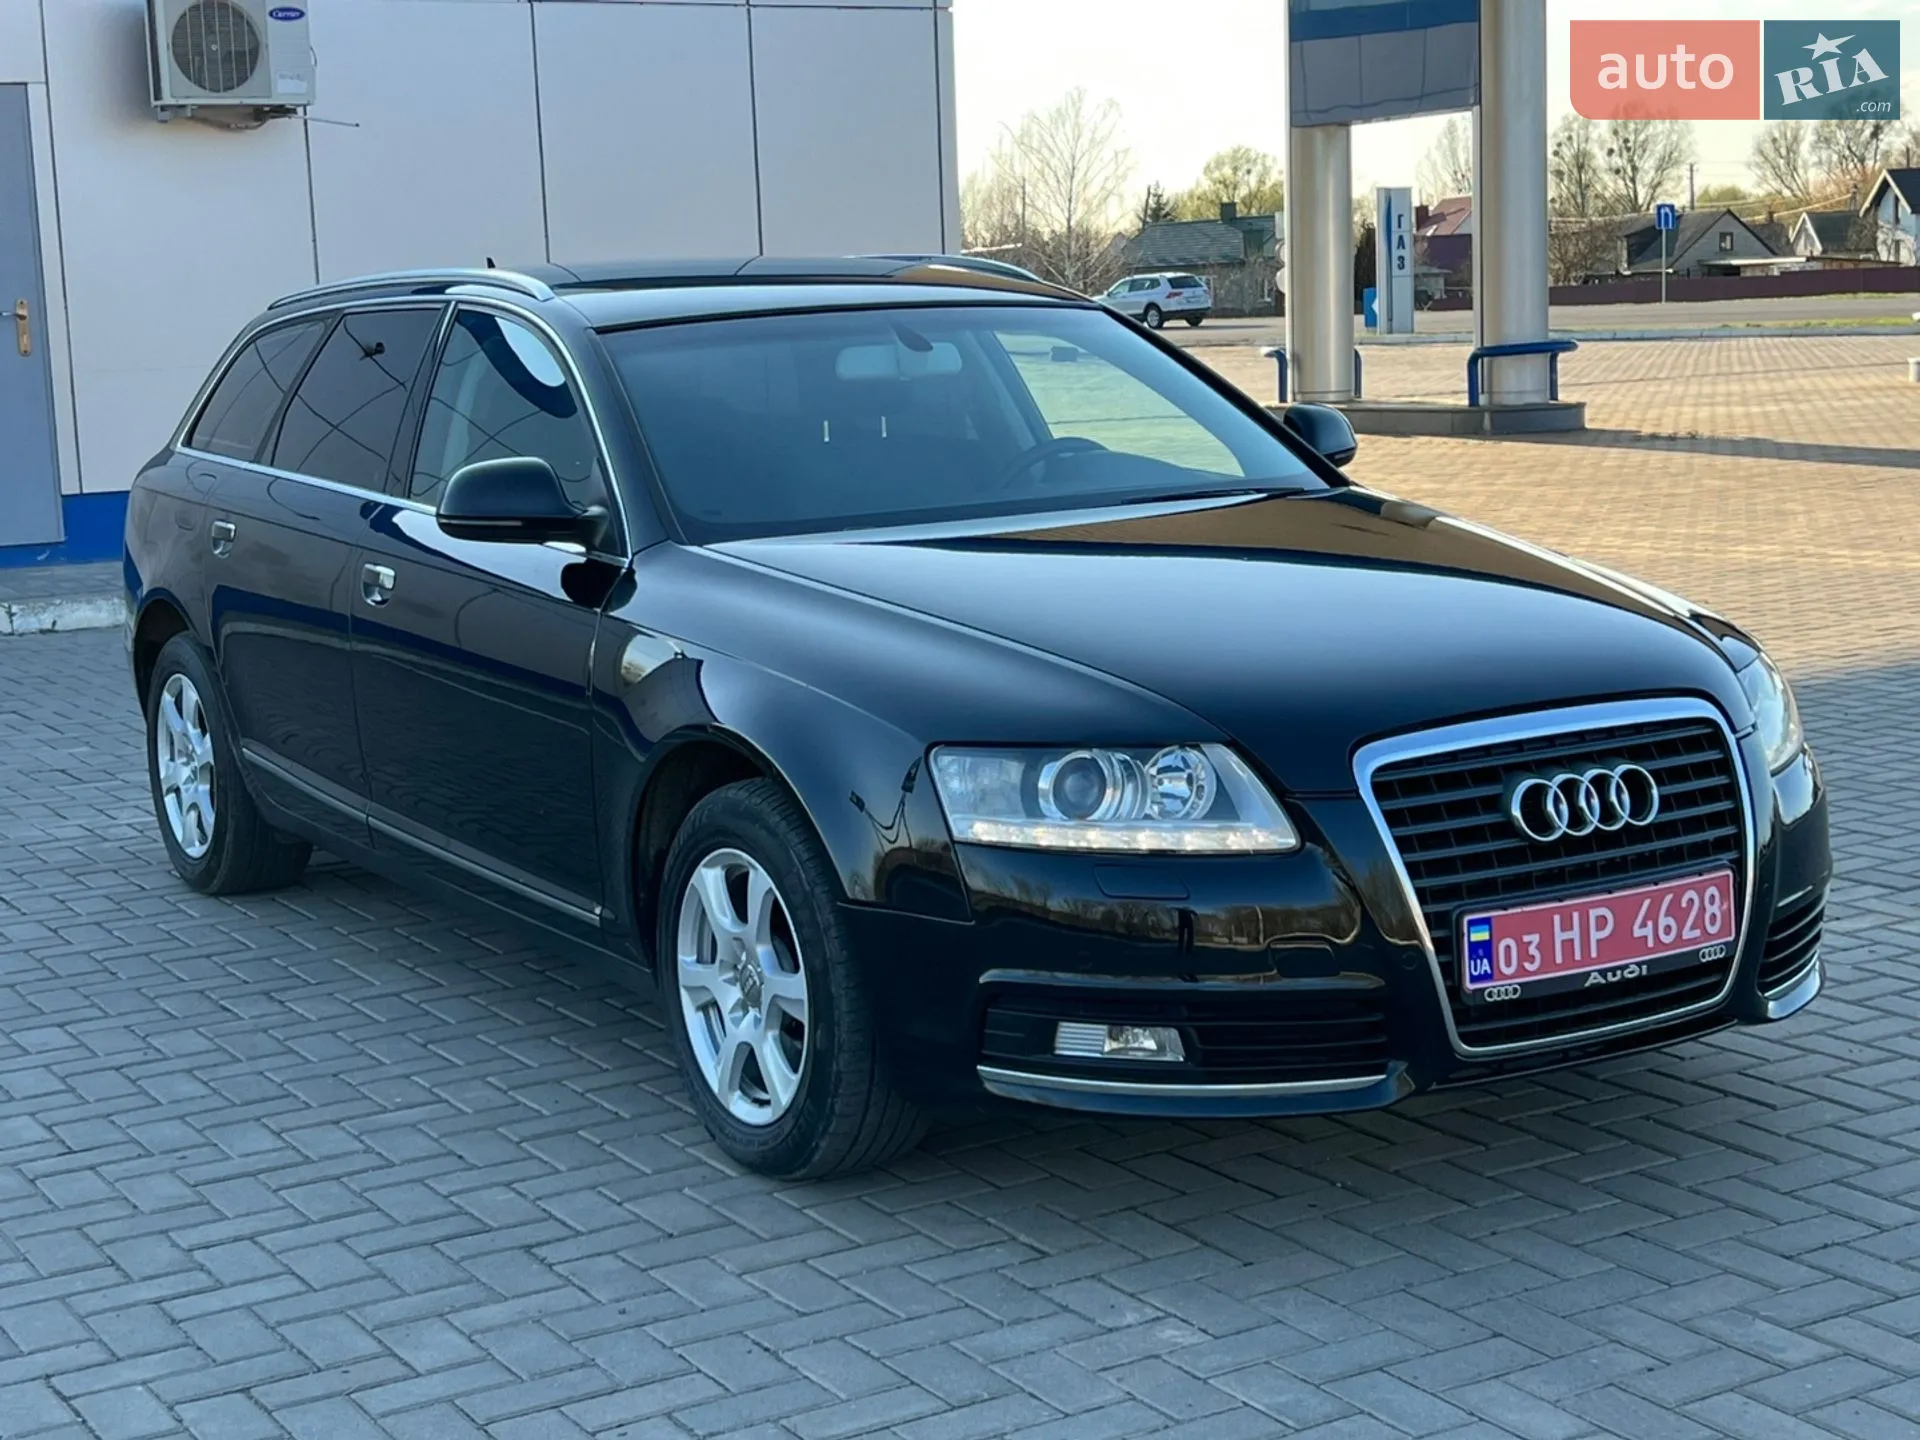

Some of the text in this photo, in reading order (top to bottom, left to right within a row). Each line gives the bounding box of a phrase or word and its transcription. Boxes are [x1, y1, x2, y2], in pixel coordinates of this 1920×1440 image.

[1396, 214, 1406, 271] ГАЗ
[1497, 886, 1722, 976] 03 HP 4628
[1470, 958, 1492, 976] UA
[1584, 964, 1649, 988] Audi
